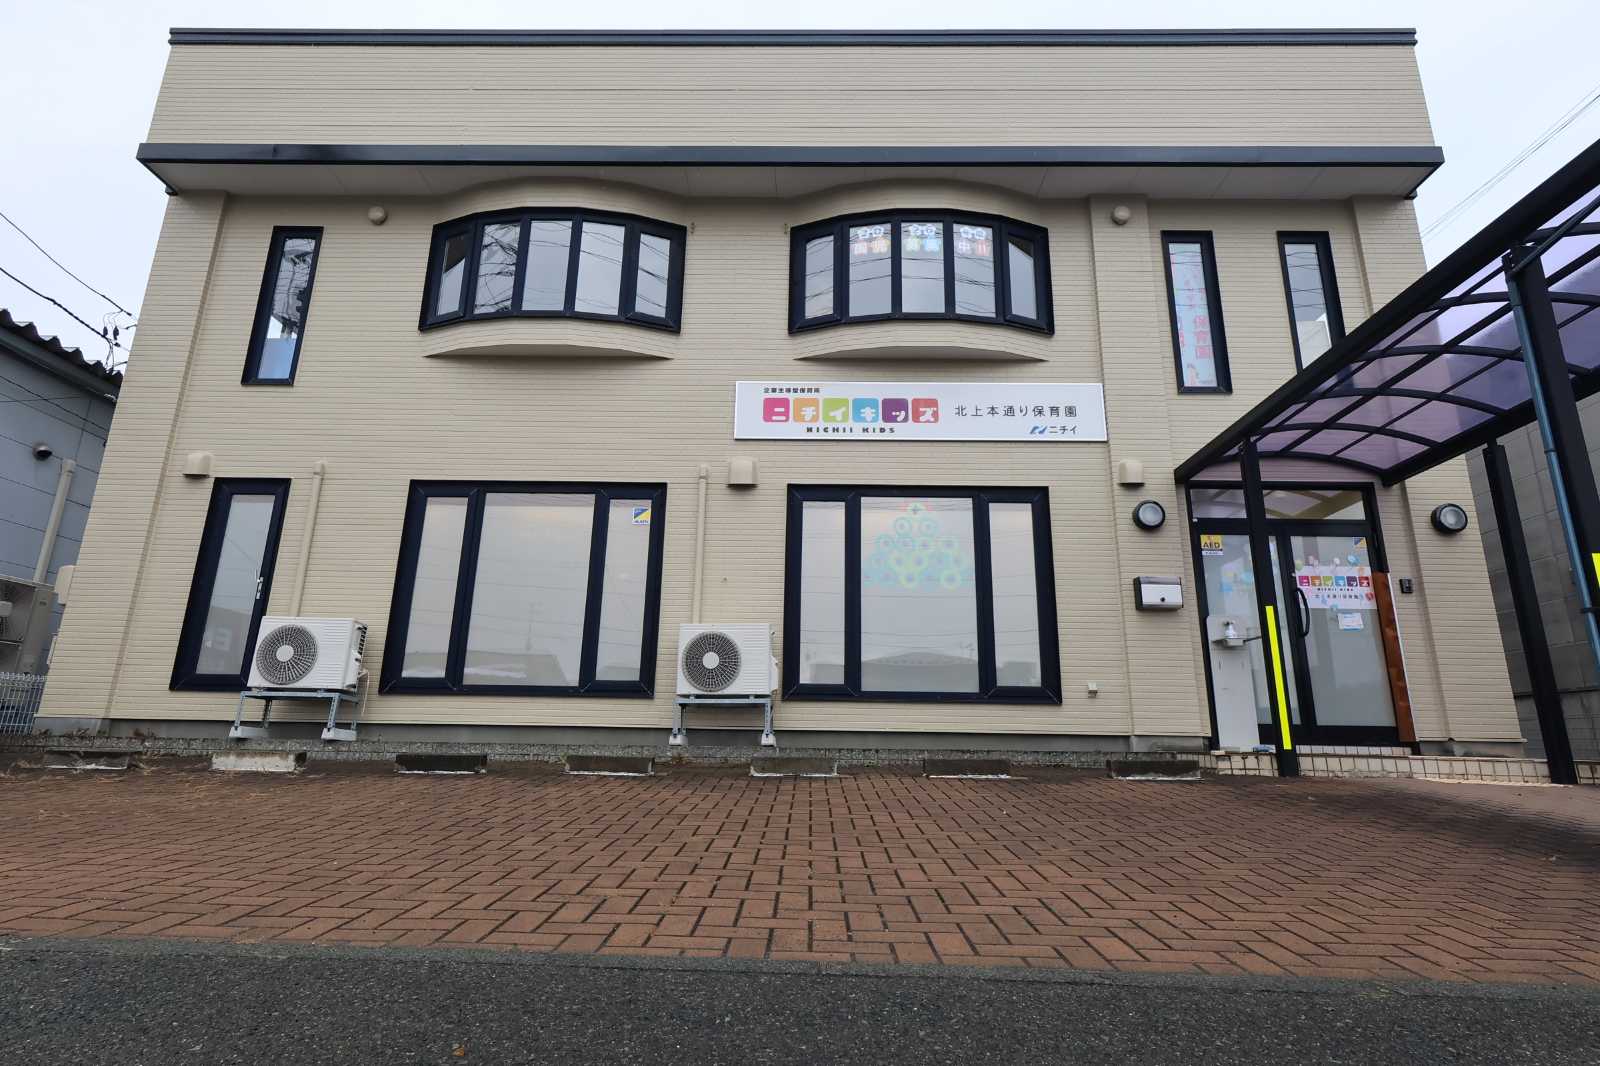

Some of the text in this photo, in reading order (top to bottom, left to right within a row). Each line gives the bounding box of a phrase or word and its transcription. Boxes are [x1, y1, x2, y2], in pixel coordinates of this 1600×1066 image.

[767, 402, 938, 422] ニチイキッズ
[954, 405, 1077, 418] 北上本通り保育園
[1048, 425, 1078, 434] ニチイ
